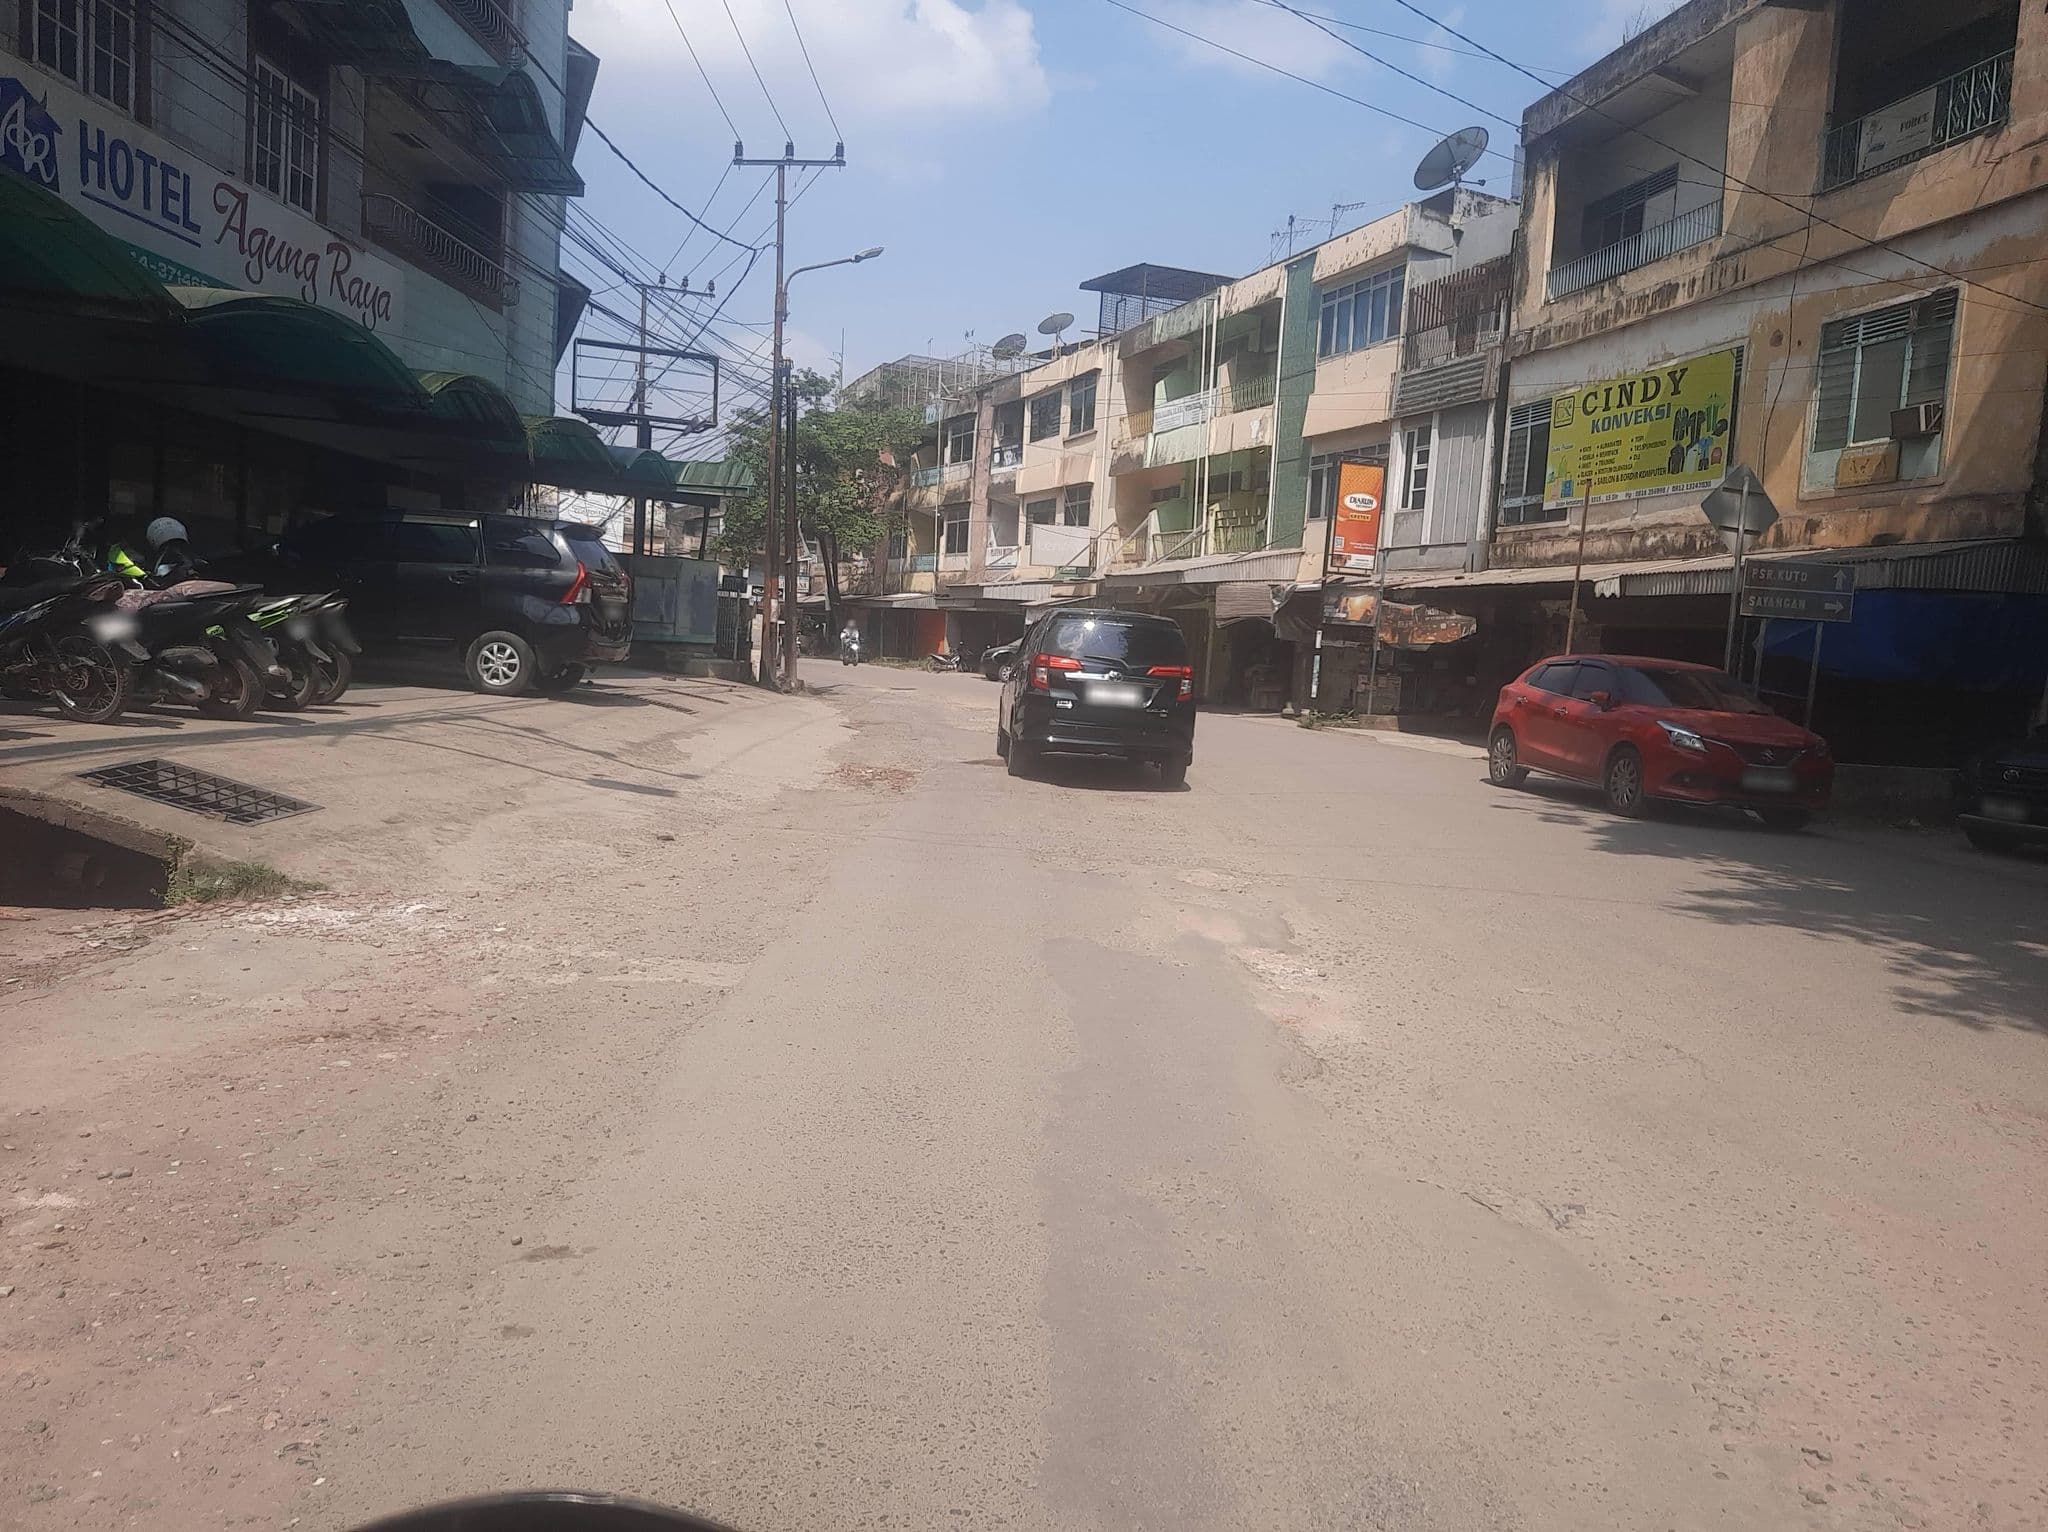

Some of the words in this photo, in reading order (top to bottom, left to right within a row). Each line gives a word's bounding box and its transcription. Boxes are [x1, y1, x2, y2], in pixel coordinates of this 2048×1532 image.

[79, 118, 202, 234] HOTEL
[213, 182, 321, 305] Agung
[326, 241, 392, 332] Raya
[1581, 367, 1689, 416] CINDY
[1590, 403, 1672, 435] KONVEKSI
[1639, 466, 1667, 479] KOMPUTER
[1748, 595, 1806, 609] SAYANGAN
